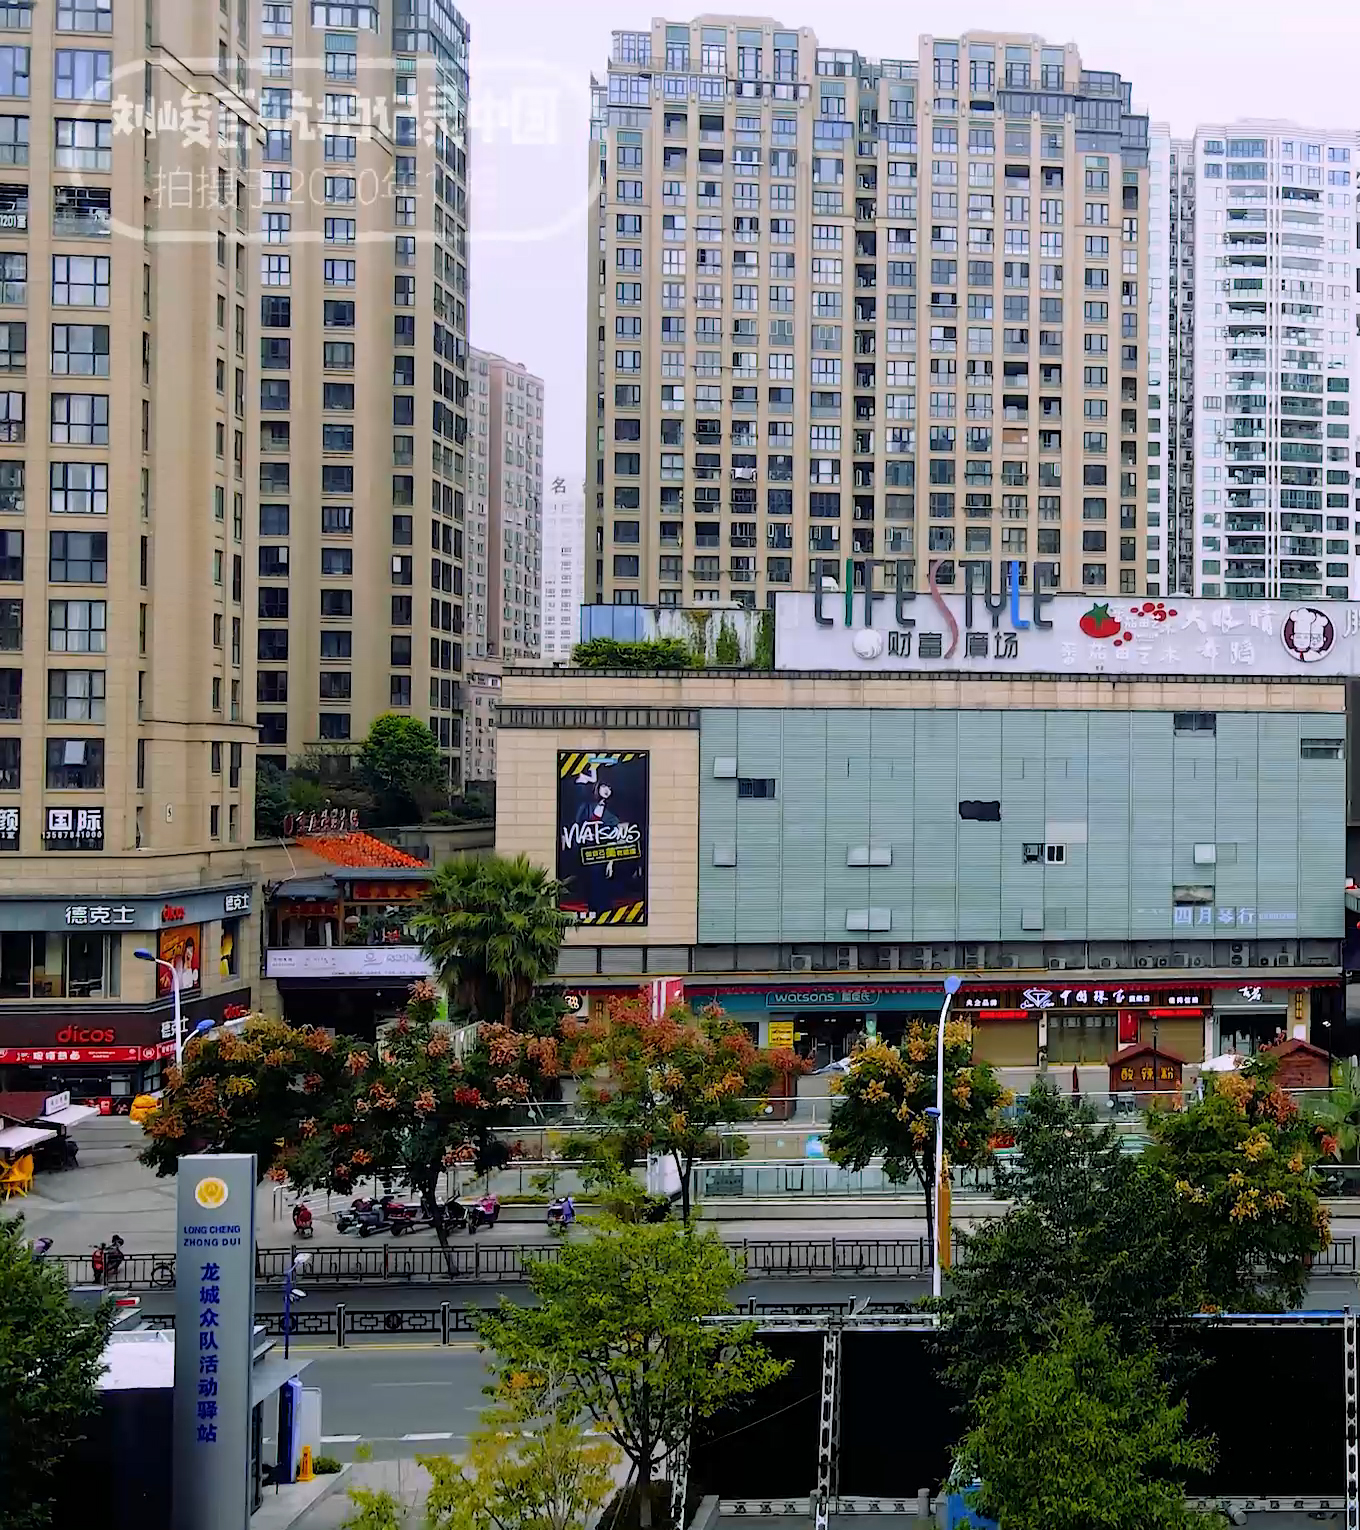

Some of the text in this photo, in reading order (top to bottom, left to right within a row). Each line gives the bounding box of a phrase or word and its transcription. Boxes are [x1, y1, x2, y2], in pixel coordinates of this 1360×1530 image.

[49, 808, 102, 832] 国际
[561, 820, 641, 851] WATSONS
[64, 904, 136, 925] 德克士
[1174, 906, 1257, 926] 四月琴行
[774, 990, 835, 1003] watsons
[57, 1025, 116, 1044] dicos
[183, 1225, 241, 1235] LONG CHENG
[183, 1238, 241, 1247] ZHONG DUI
[196, 1262, 221, 1444] 龙城众队活动驿站
